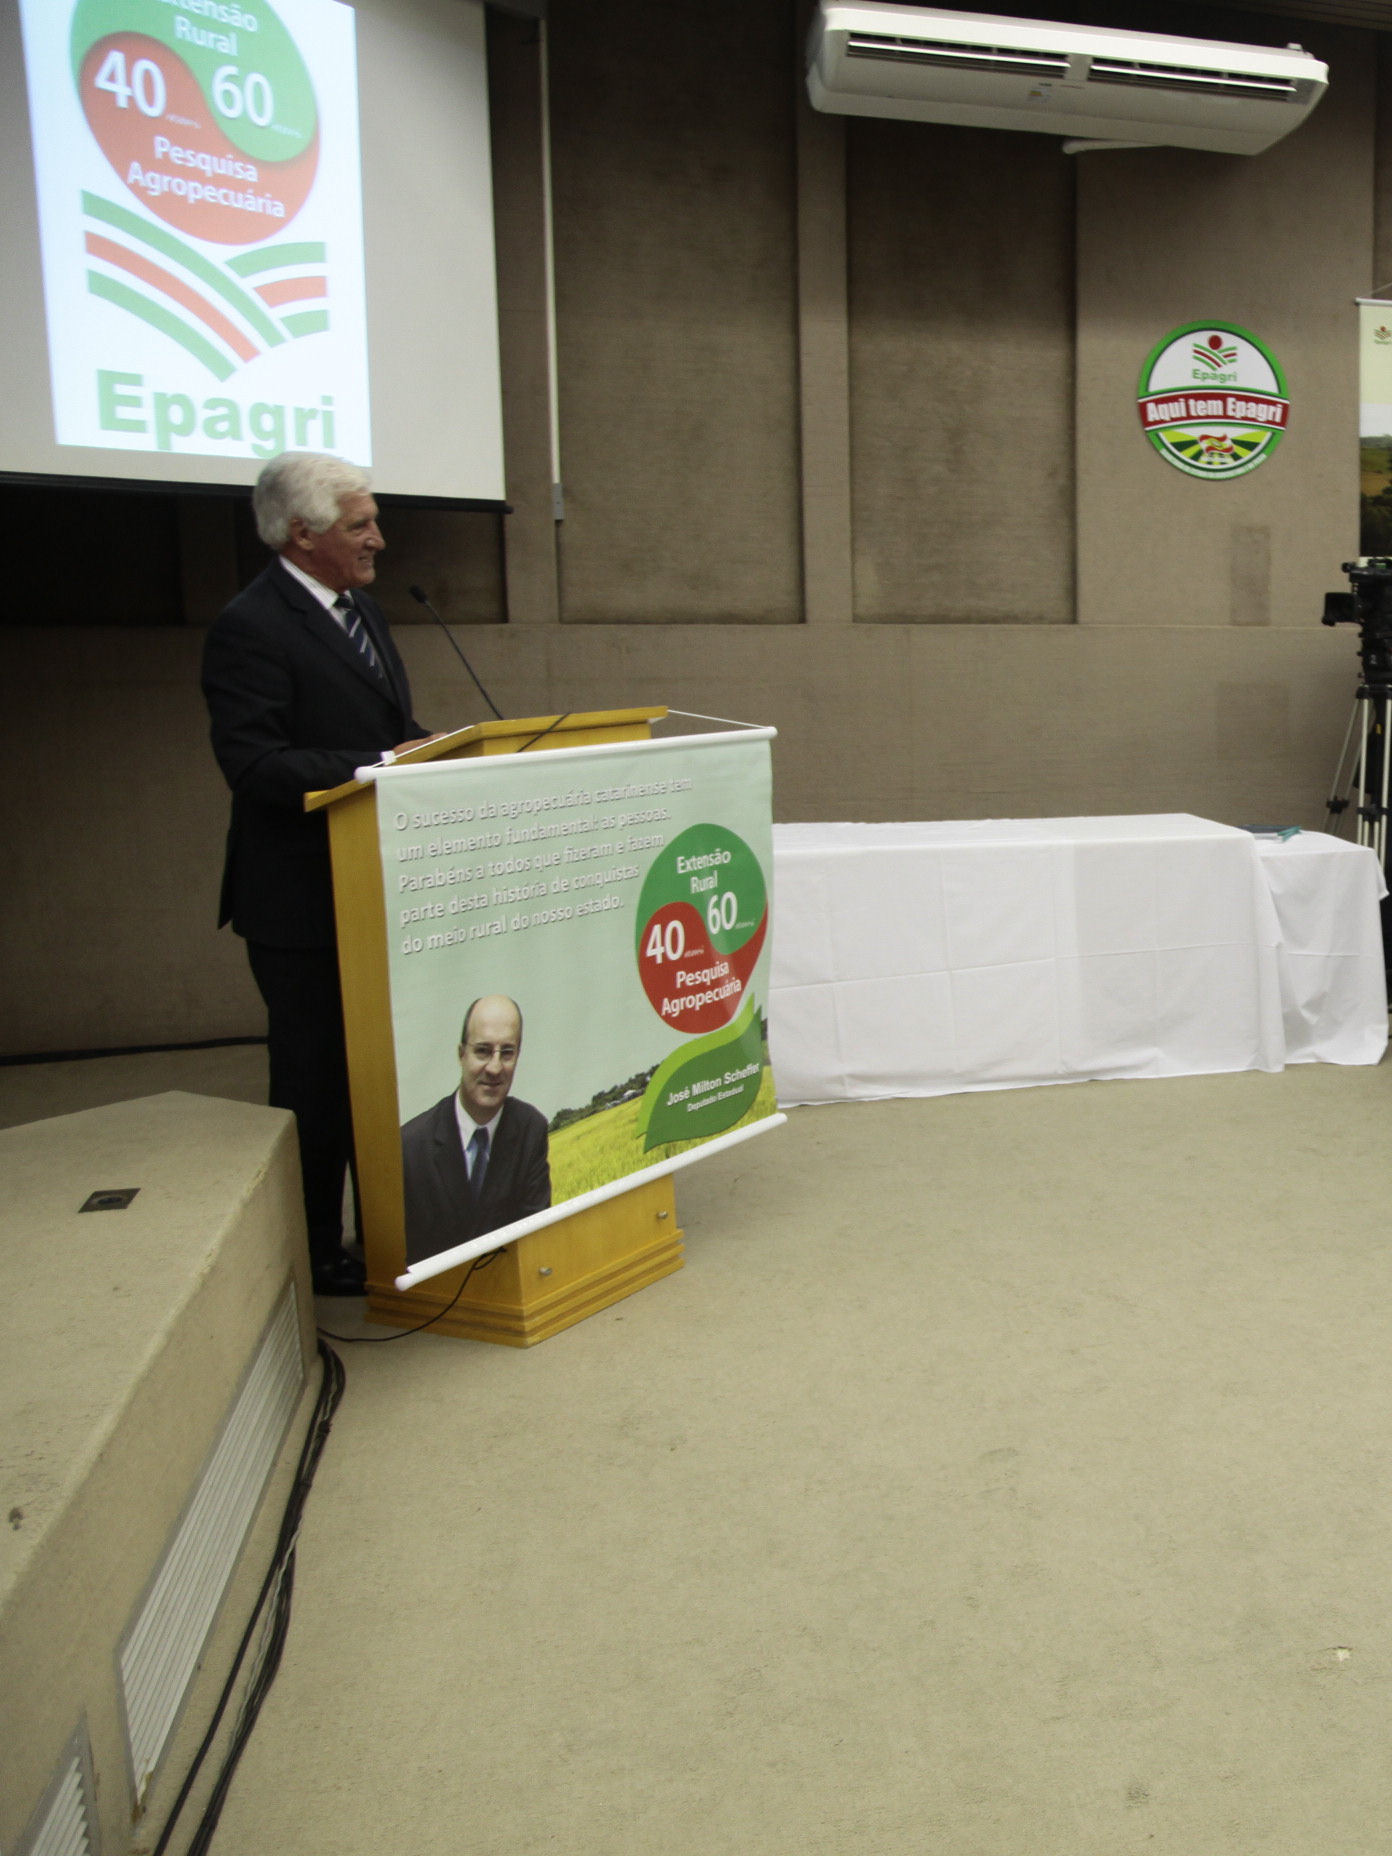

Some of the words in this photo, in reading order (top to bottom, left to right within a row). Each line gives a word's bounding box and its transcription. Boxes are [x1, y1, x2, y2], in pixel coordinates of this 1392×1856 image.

[174, 15, 239, 56] Rural
[94, 50, 167, 118] 40
[211, 65, 274, 127] 60
[153, 135, 259, 183] Pesquisa
[126, 161, 286, 218] Agropecuária
[1192, 369, 1238, 383] Epagri
[97, 369, 337, 460] Epagri
[1146, 399, 1187, 422] Aqui
[1188, 399, 1224, 416] tem
[1226, 397, 1284, 423] Epagri
[395, 812, 409, 831] O
[414, 807, 475, 829] sucesso
[479, 801, 498, 820] da
[501, 789, 592, 819] agropecuária
[596, 781, 668, 803] catarinense
[669, 779, 693, 793] tem
[397, 845, 424, 863] um
[428, 833, 502, 857] elemento
[602, 816, 616, 830] as
[620, 808, 672, 831] pessoas.
[399, 867, 473, 893] Parabéns
[476, 866, 484, 879] a
[488, 855, 531, 877] todos
[535, 852, 561, 873] que
[564, 843, 614, 864] fizeram
[616, 842, 625, 854] e
[677, 849, 731, 874] Extensão
[690, 870, 718, 894] Rural
[400, 902, 445, 930] parte
[448, 894, 489, 915] desta
[493, 881, 548, 906] história
[552, 877, 570, 895] de
[573, 865, 640, 889] conquistas
[402, 935, 424, 955] do
[427, 927, 467, 950] meio
[470, 915, 508, 940] rural
[511, 912, 530, 932] do
[532, 906, 574, 927] nosso
[576, 893, 625, 917] estado.
[645, 920, 686, 964] 40
[707, 891, 738, 935] 60
[661, 977, 742, 1018] Agropecuária
[676, 961, 730, 988] Pesquisa
[666, 1086, 690, 1106] José
[691, 1077, 722, 1096] Milton
[723, 1063, 760, 1085] Scheffer
[686, 1095, 717, 1113] Deputado
[717, 1084, 745, 1101] Estadual
